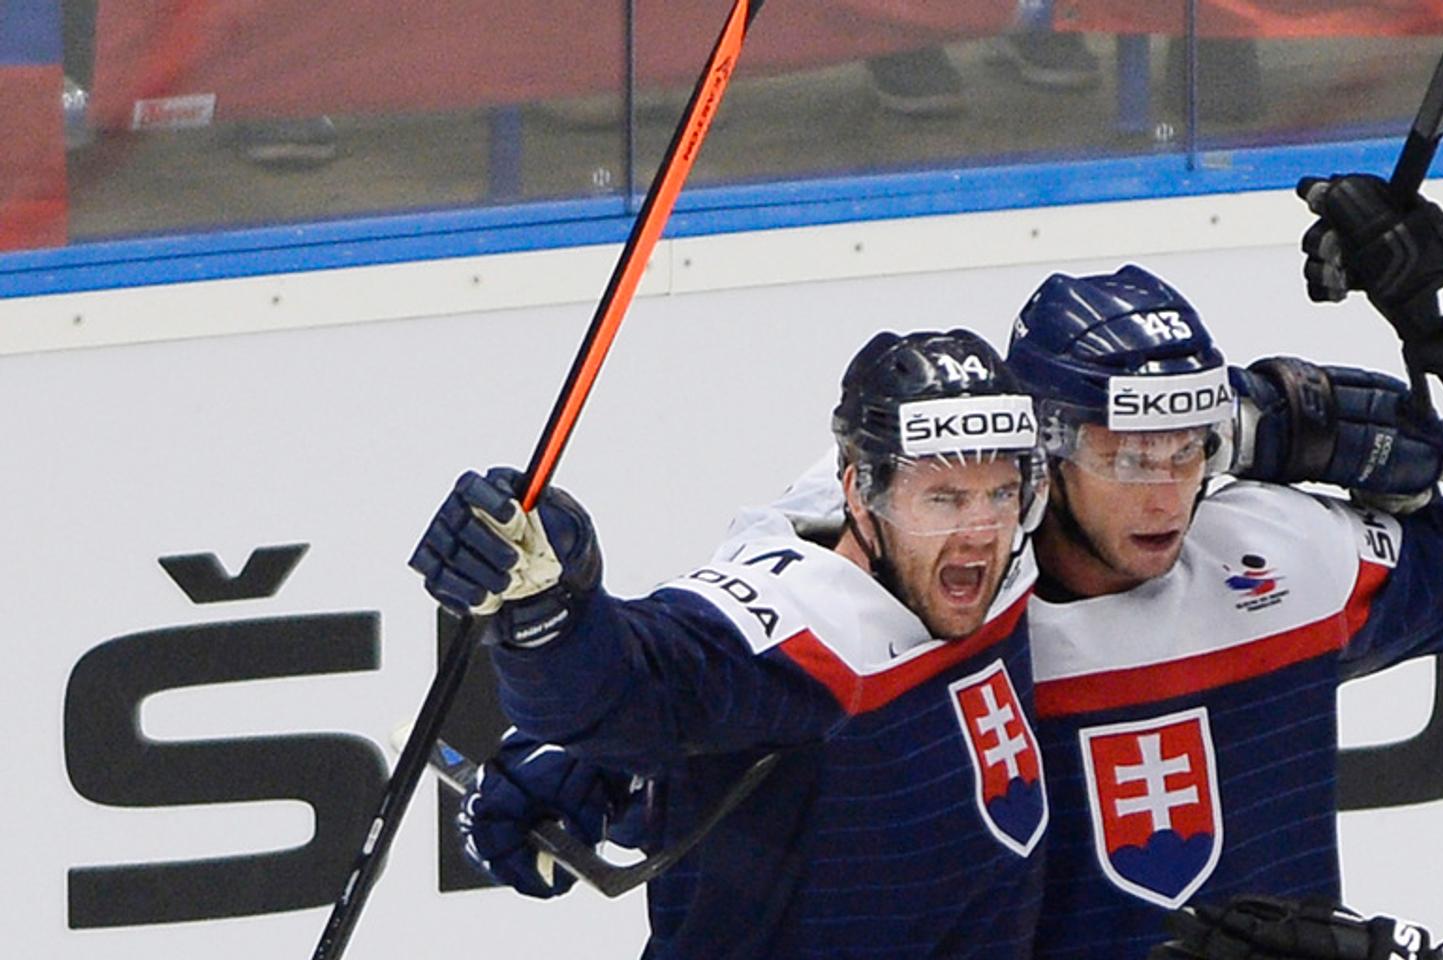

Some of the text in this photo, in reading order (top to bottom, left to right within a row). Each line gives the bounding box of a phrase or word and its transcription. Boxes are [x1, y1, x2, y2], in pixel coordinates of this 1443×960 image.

[1141, 311, 1193, 341] 43
[936, 354, 989, 383] 14
[1113, 383, 1233, 416] ŠKODA
[906, 412, 1035, 441] ŠKODA
[689, 568, 780, 639] ODA
